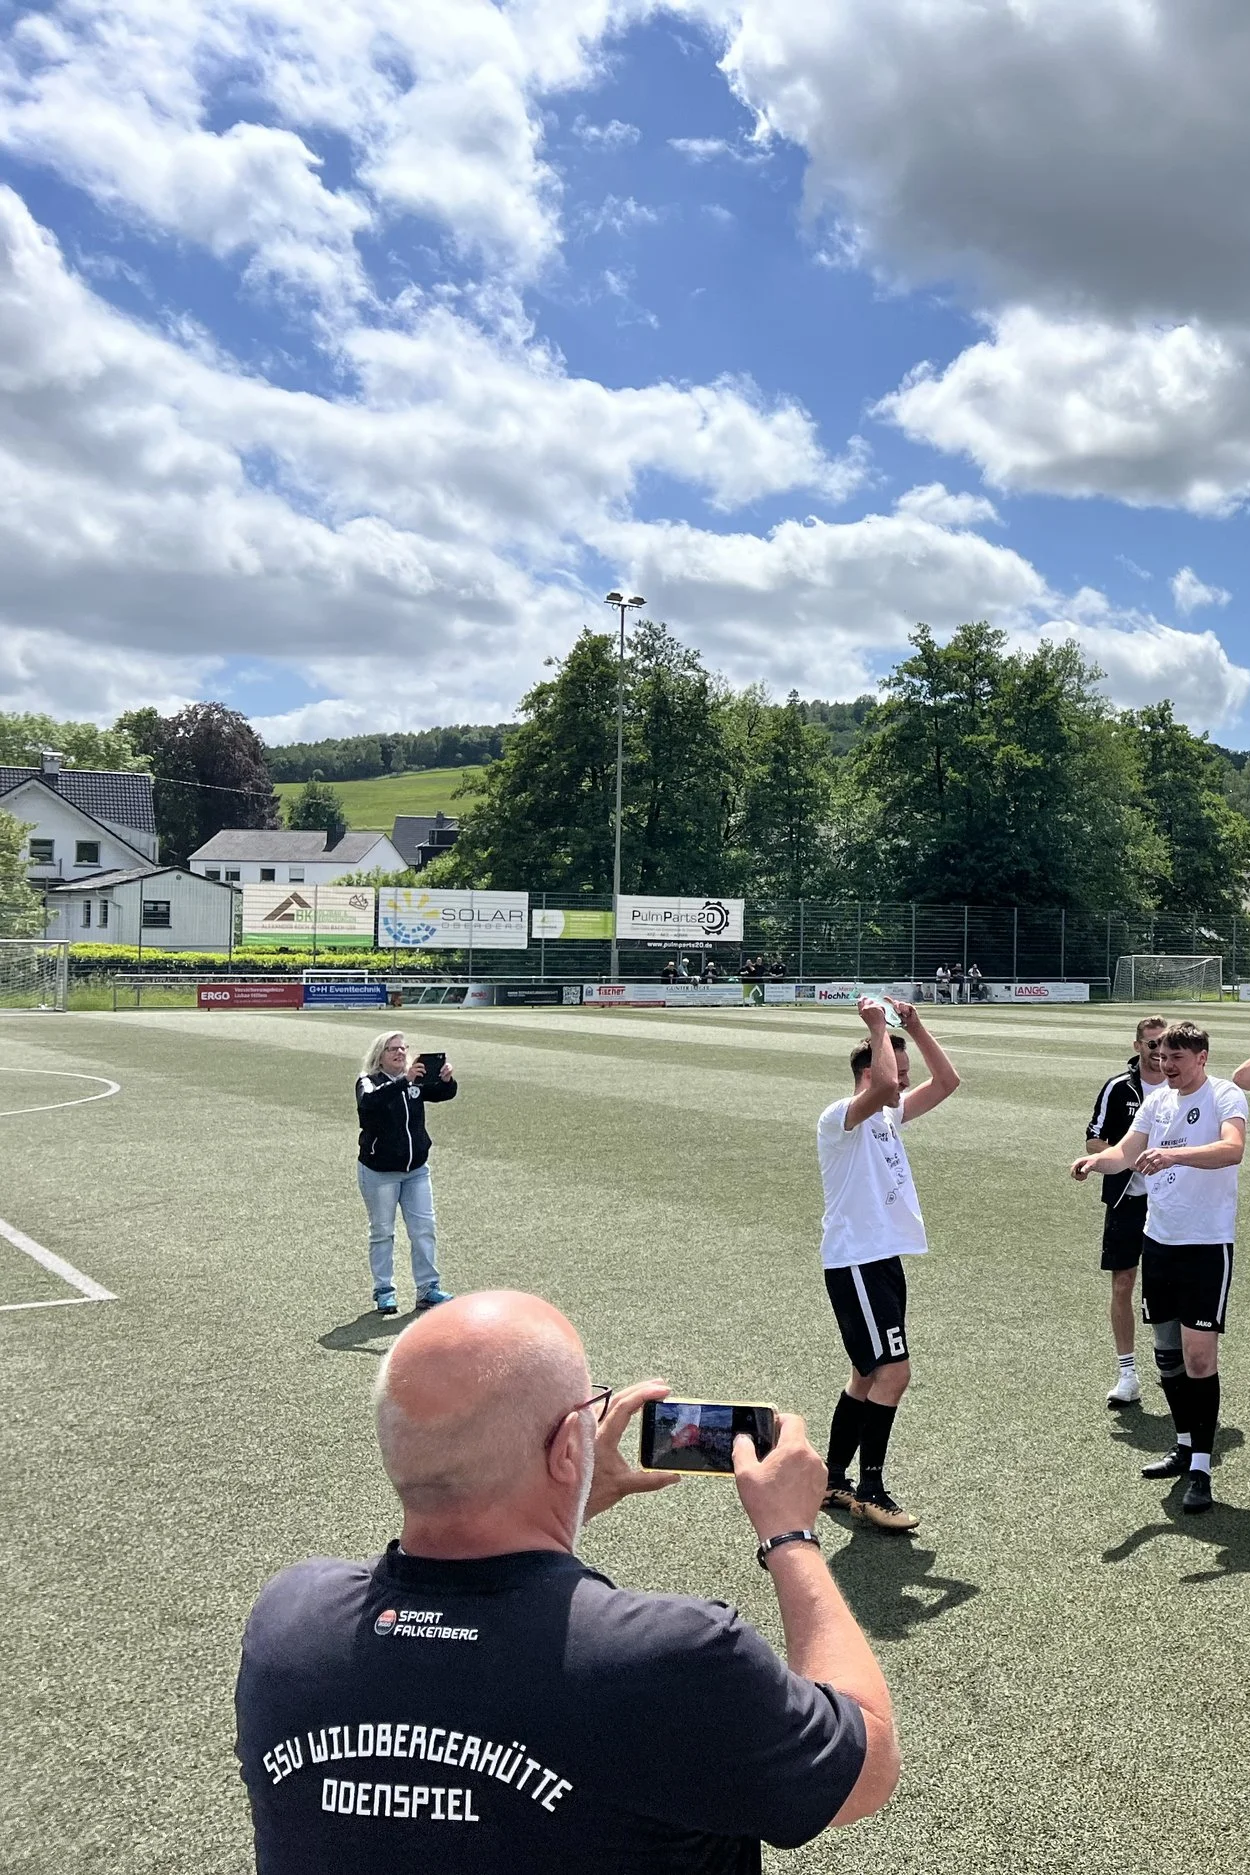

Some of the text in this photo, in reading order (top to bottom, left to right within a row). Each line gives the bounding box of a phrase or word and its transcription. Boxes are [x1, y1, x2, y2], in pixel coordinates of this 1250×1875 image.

[441, 908, 523, 922] SOLAR
[631, 909, 715, 924] PulmParts20
[200, 991, 231, 1001] ERGO
[309, 985, 328, 993] G+H
[329, 985, 381, 993] Eventtechnik
[1015, 986, 1049, 996] LANGE
[1195, 1320, 1213, 1328] JAKO
[886, 1326, 906, 1357] 6
[398, 1610, 444, 1624] SPORT
[393, 1624, 479, 1641] FALKENBERG
[262, 1723, 574, 1813] SSV WILDBERGERHÜTTE
[321, 1778, 480, 1822] ODENSPIEL
